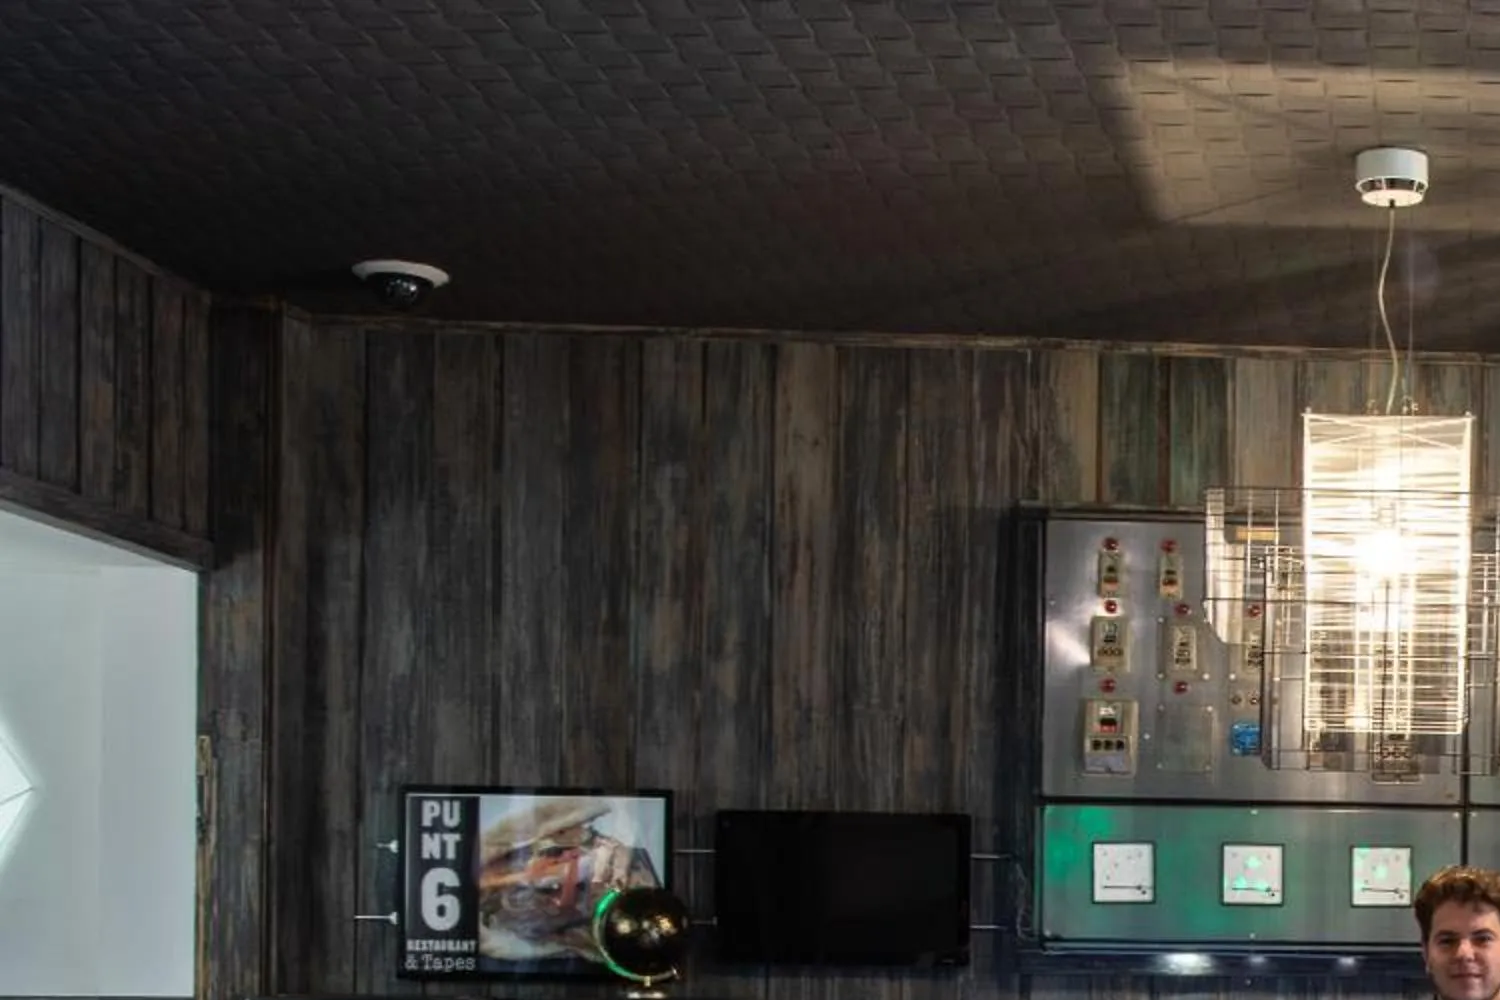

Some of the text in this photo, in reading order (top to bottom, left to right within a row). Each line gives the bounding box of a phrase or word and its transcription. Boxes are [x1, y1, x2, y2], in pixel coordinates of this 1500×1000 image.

[421, 800, 461, 827] PU
[421, 833, 461, 859] NT
[421, 867, 461, 931] 6
